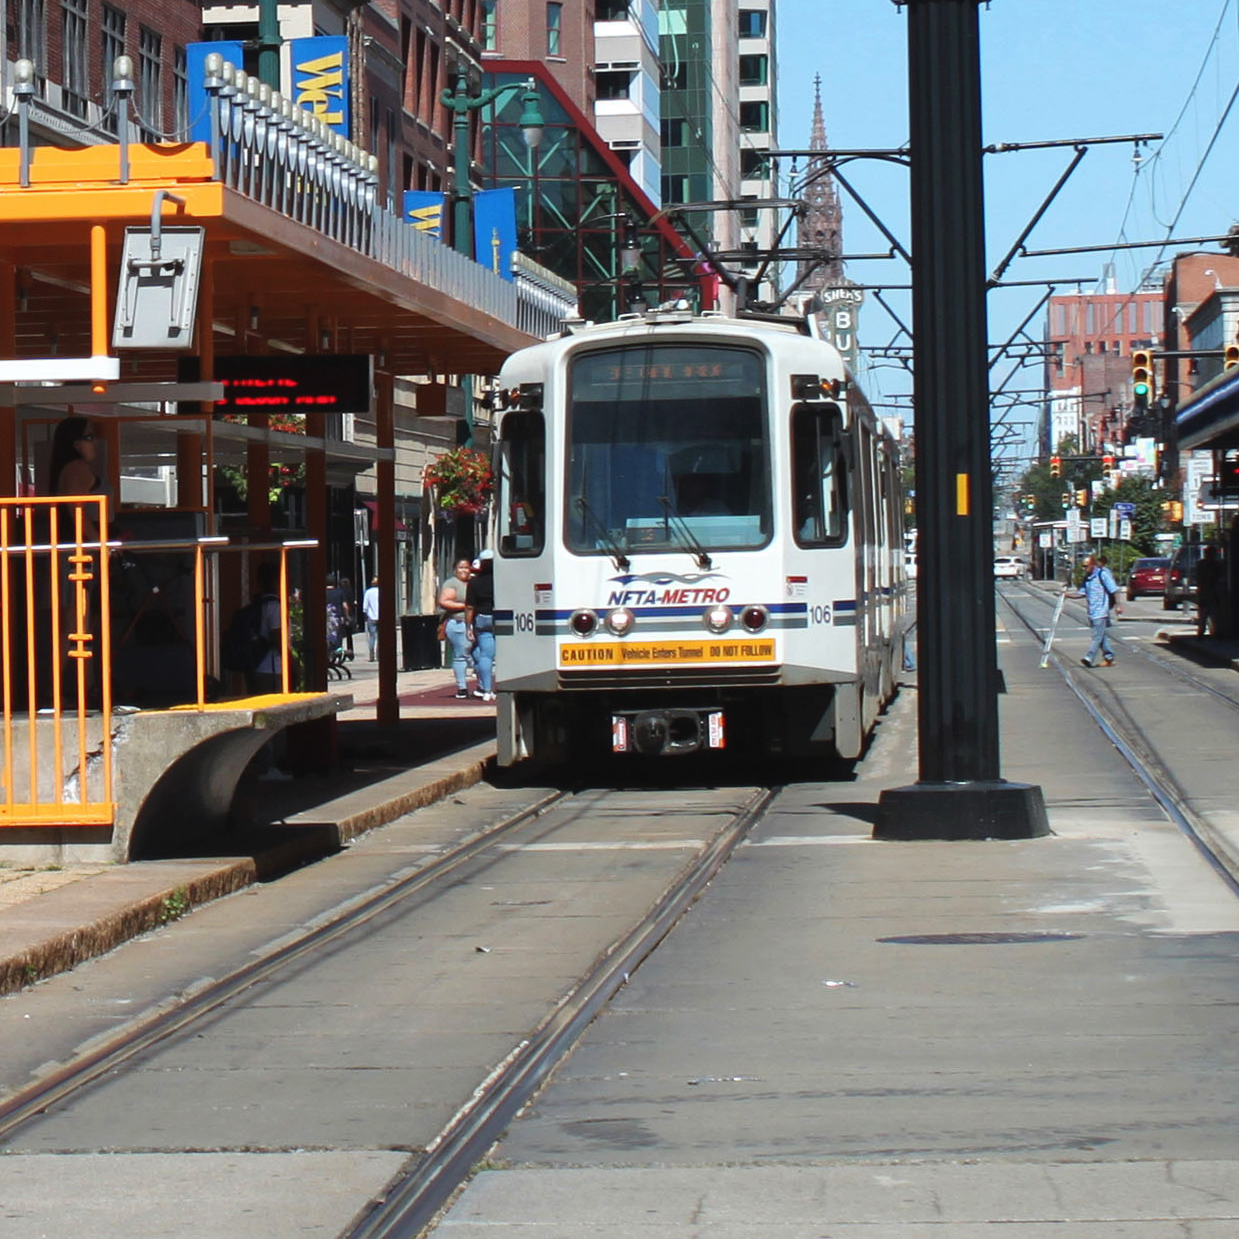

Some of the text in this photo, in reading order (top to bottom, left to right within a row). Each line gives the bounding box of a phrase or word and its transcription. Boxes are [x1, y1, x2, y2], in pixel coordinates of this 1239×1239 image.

[836, 312, 850, 360] BU
[608, 587, 730, 606] NFTA-METRO
[515, 613, 534, 632] 106
[809, 605, 831, 624] 106
[562, 644, 772, 661] CAUTION Vehicle Enters Tunnel DO NOT FOLLOW
